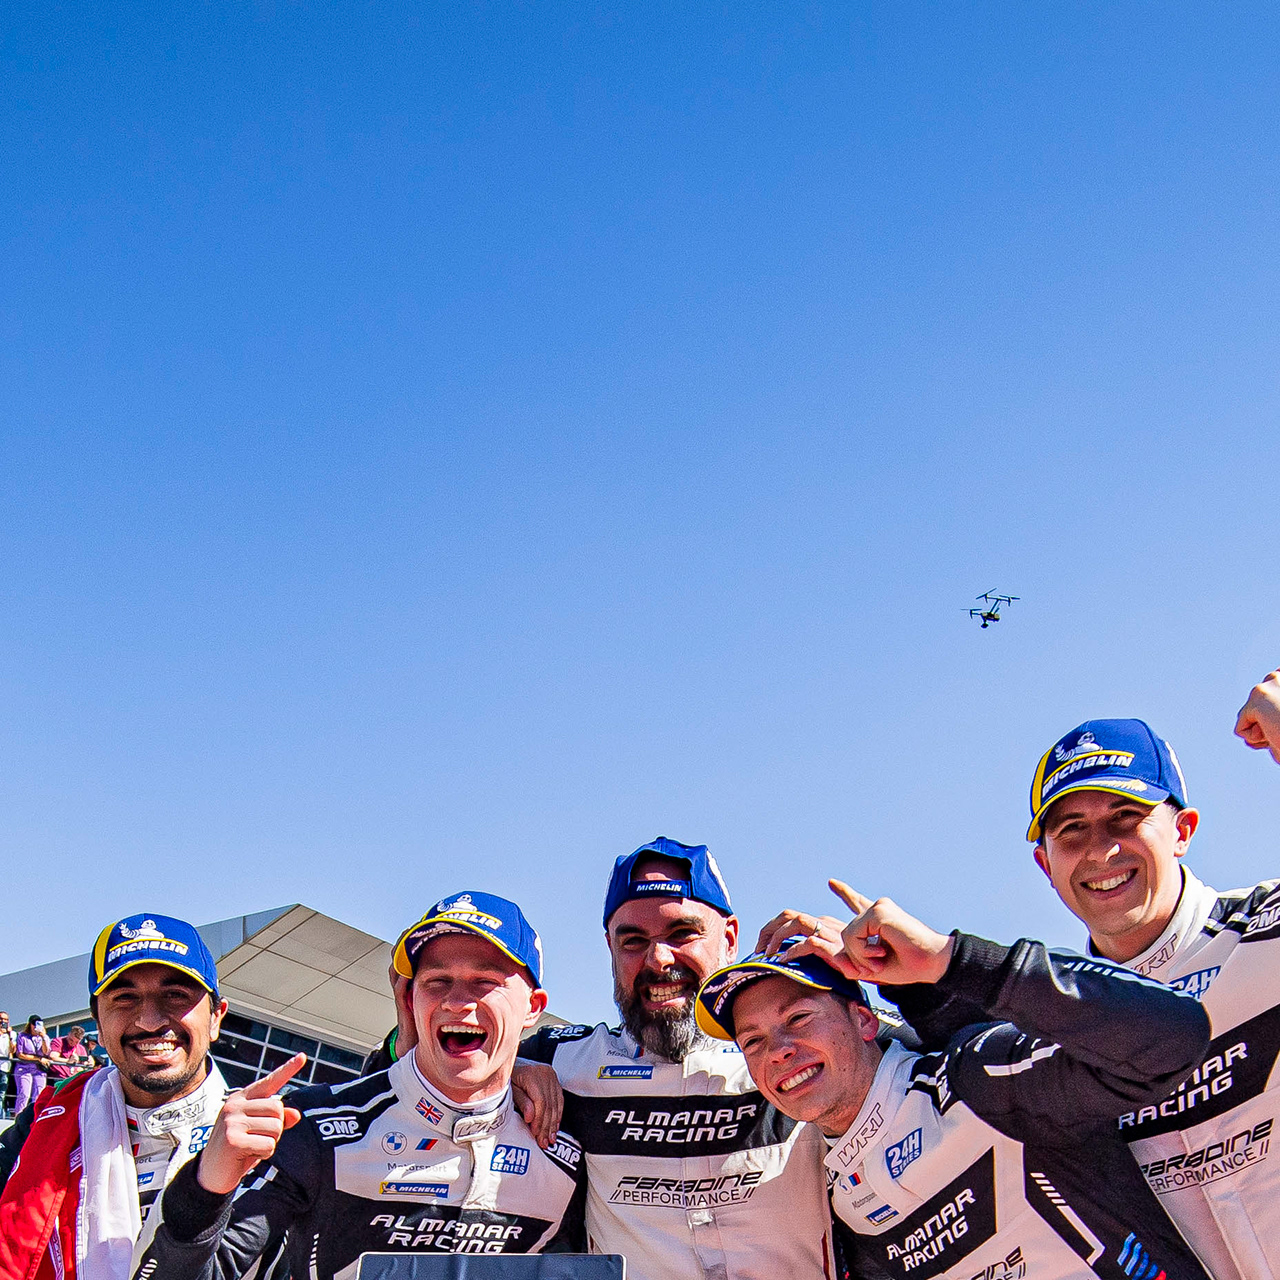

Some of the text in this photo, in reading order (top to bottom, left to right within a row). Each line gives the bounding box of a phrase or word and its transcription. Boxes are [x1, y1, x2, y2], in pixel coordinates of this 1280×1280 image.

[1042, 755, 1133, 797] MICHELIN
[636, 883, 682, 893] MICHELIN
[108, 941, 188, 963] MICHELIN
[1118, 1071, 1232, 1129] RACING
[605, 1104, 757, 1125] ALMANAR
[319, 1119, 359, 1136] OMP
[621, 1124, 739, 1143] RACING
[837, 1102, 884, 1167] WRT
[494, 1147, 528, 1165] 24H
[888, 1131, 920, 1168] 24H
[387, 1162, 447, 1173] Motorsport
[492, 1163, 525, 1173] SERIES
[1150, 1147, 1257, 1191] ERFORMANCE
[398, 1186, 448, 1194] MICHELIN
[623, 1189, 740, 1206] PERFORMANCE
[370, 1214, 522, 1239] ALMANAR
[887, 1188, 976, 1260] ALMANAR
[388, 1232, 505, 1254] RACING
[902, 1216, 969, 1271] RACING
